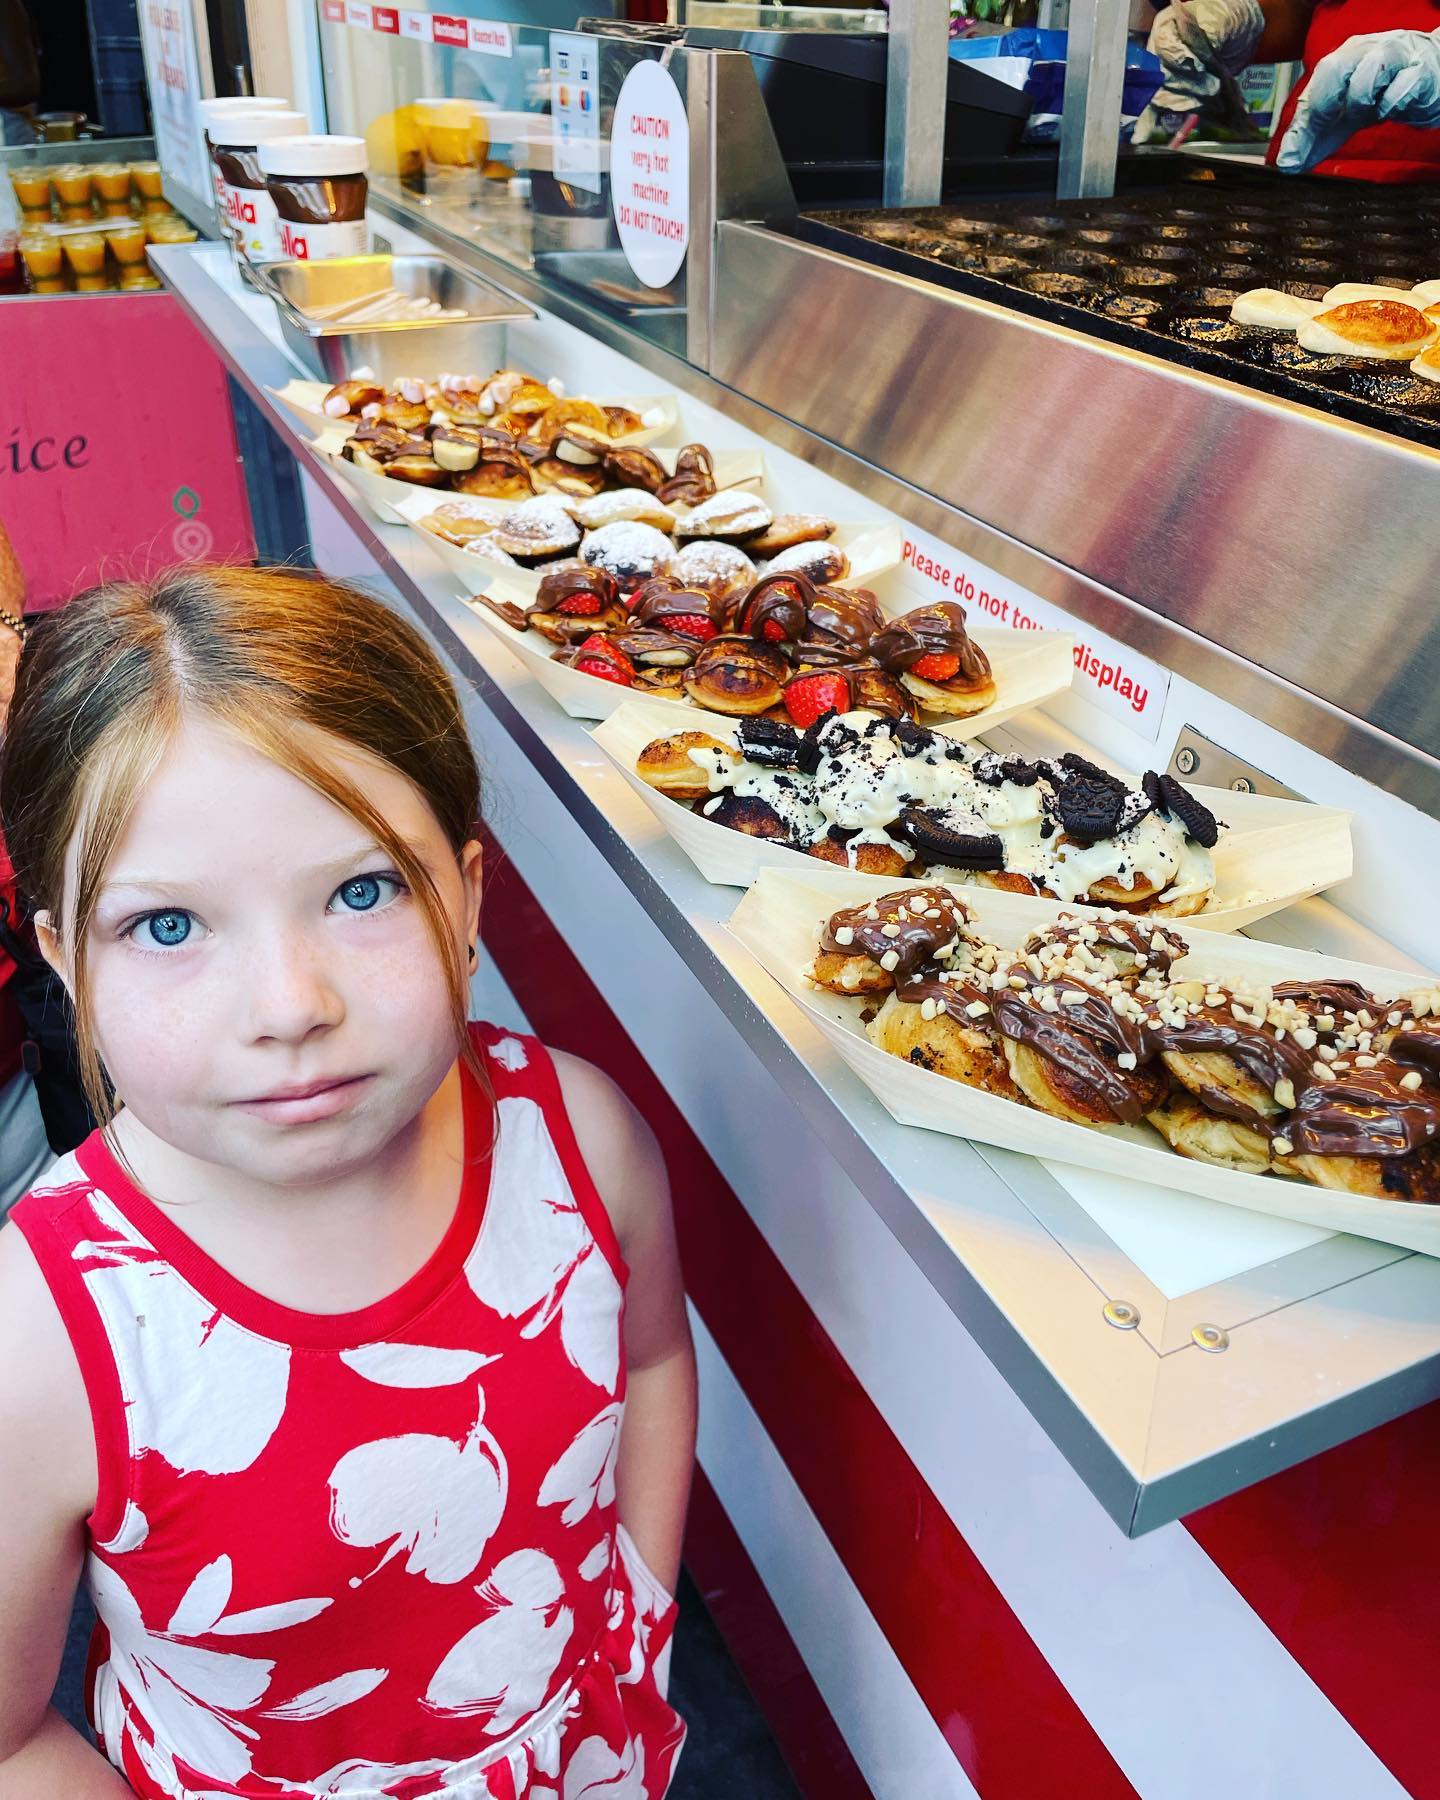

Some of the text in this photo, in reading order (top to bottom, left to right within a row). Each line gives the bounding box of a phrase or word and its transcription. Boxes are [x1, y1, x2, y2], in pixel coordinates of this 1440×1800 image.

[631, 114, 669, 138] CAUTION
[631, 150, 669, 173] very hot
[631, 181, 669, 204] machine
[619, 205, 685, 241] DO NOT TOUCH!
[0, 427, 91, 475] ice
[902, 540, 951, 586] Please
[954, 574, 975, 601] do
[978, 590, 1009, 622] not
[1073, 644, 1149, 713] display
